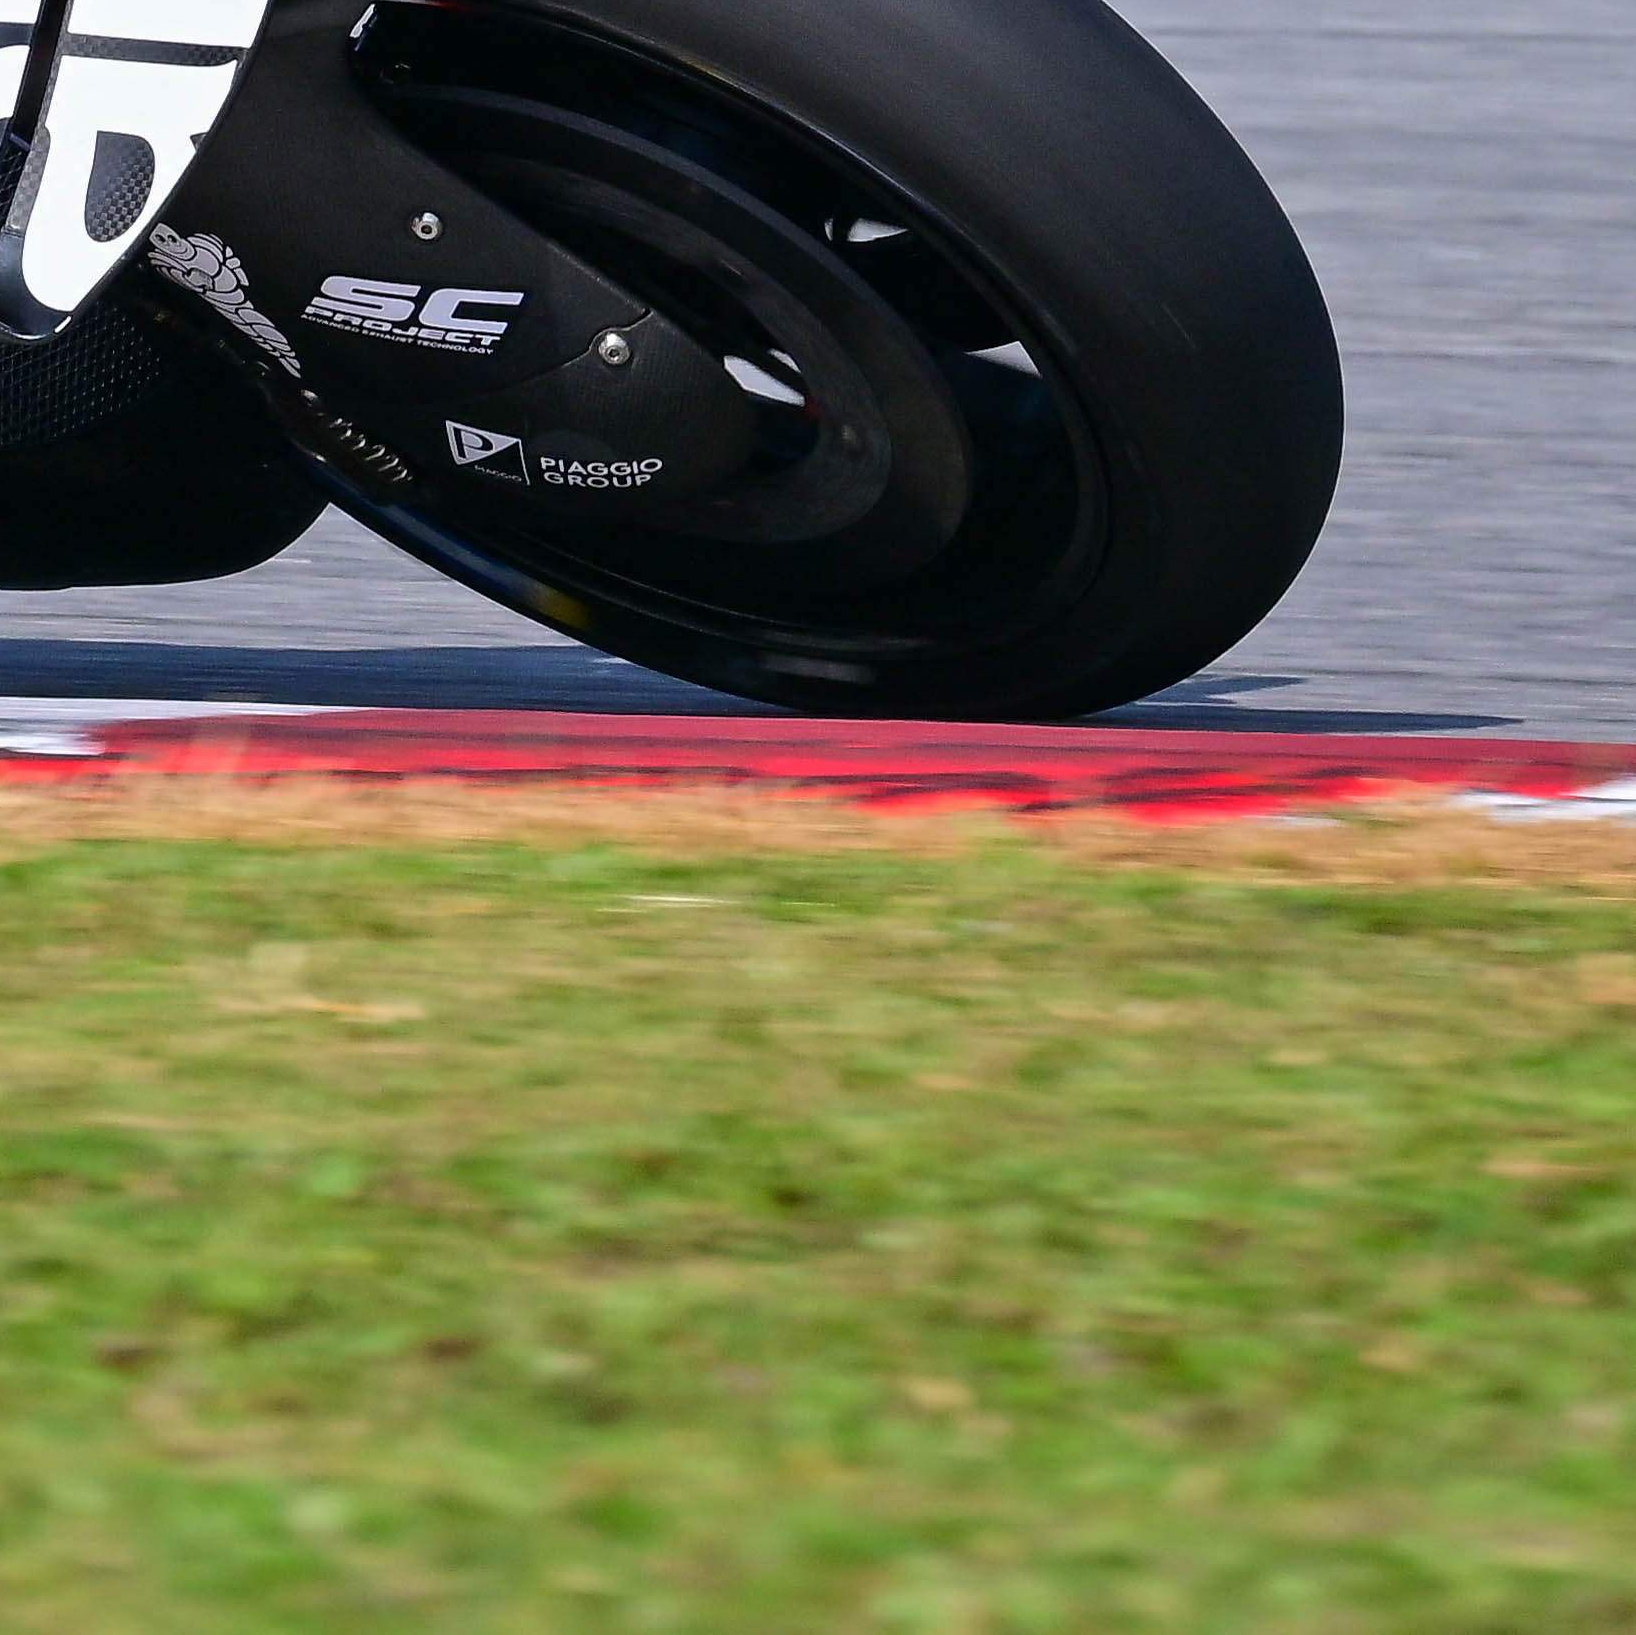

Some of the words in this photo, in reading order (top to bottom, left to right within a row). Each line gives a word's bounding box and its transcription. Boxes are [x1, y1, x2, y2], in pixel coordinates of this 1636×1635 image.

[312, 276, 524, 334] SC
[304, 306, 500, 345] PROJECT
[417, 339, 493, 355] TECHNOLOGY
[540, 457, 663, 475] PIAGGIO
[543, 472, 651, 488] GROUP
